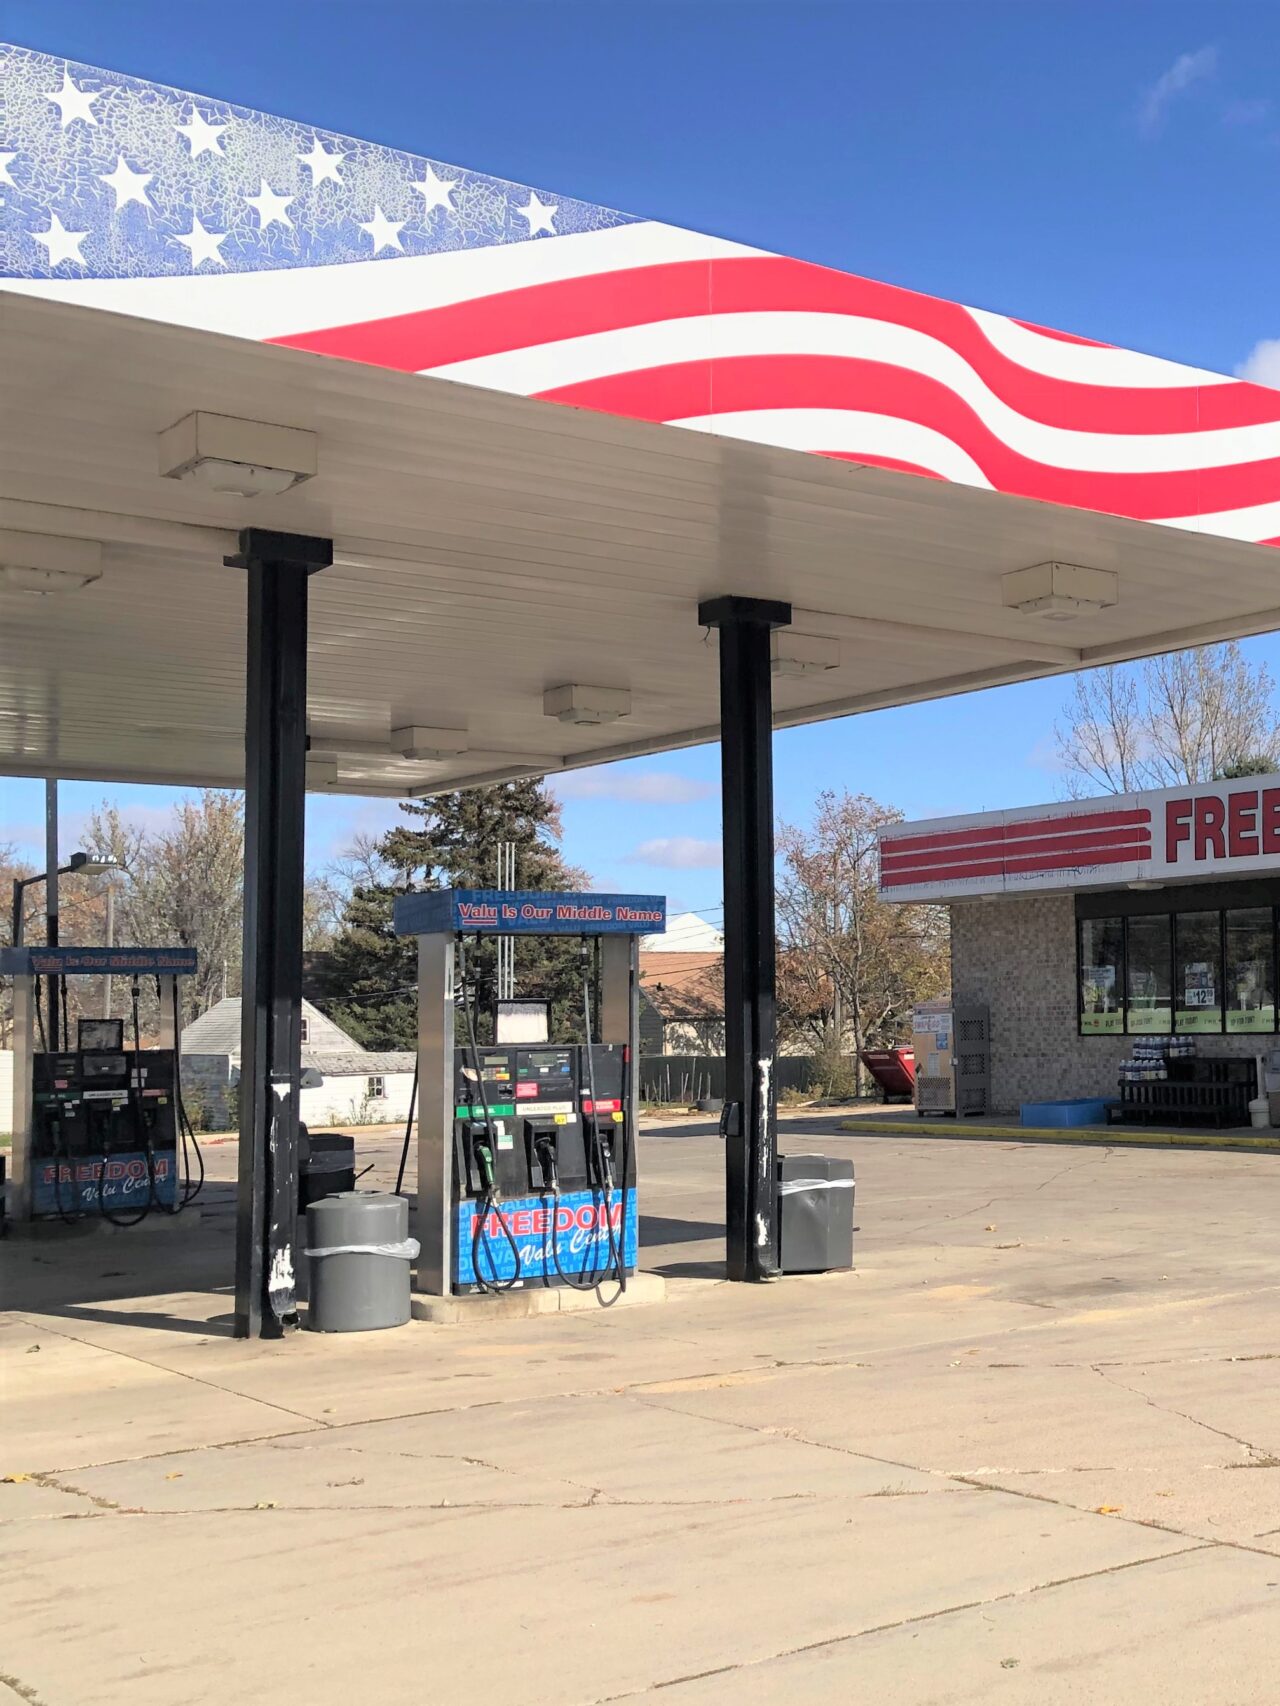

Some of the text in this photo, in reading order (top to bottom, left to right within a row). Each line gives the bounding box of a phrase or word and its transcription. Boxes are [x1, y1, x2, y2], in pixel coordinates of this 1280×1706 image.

[458, 902, 663, 922] Valu Is Our Middle Name
[42, 1157, 169, 1185] FREEDOM
[470, 1202, 624, 1239] FREEDOM
